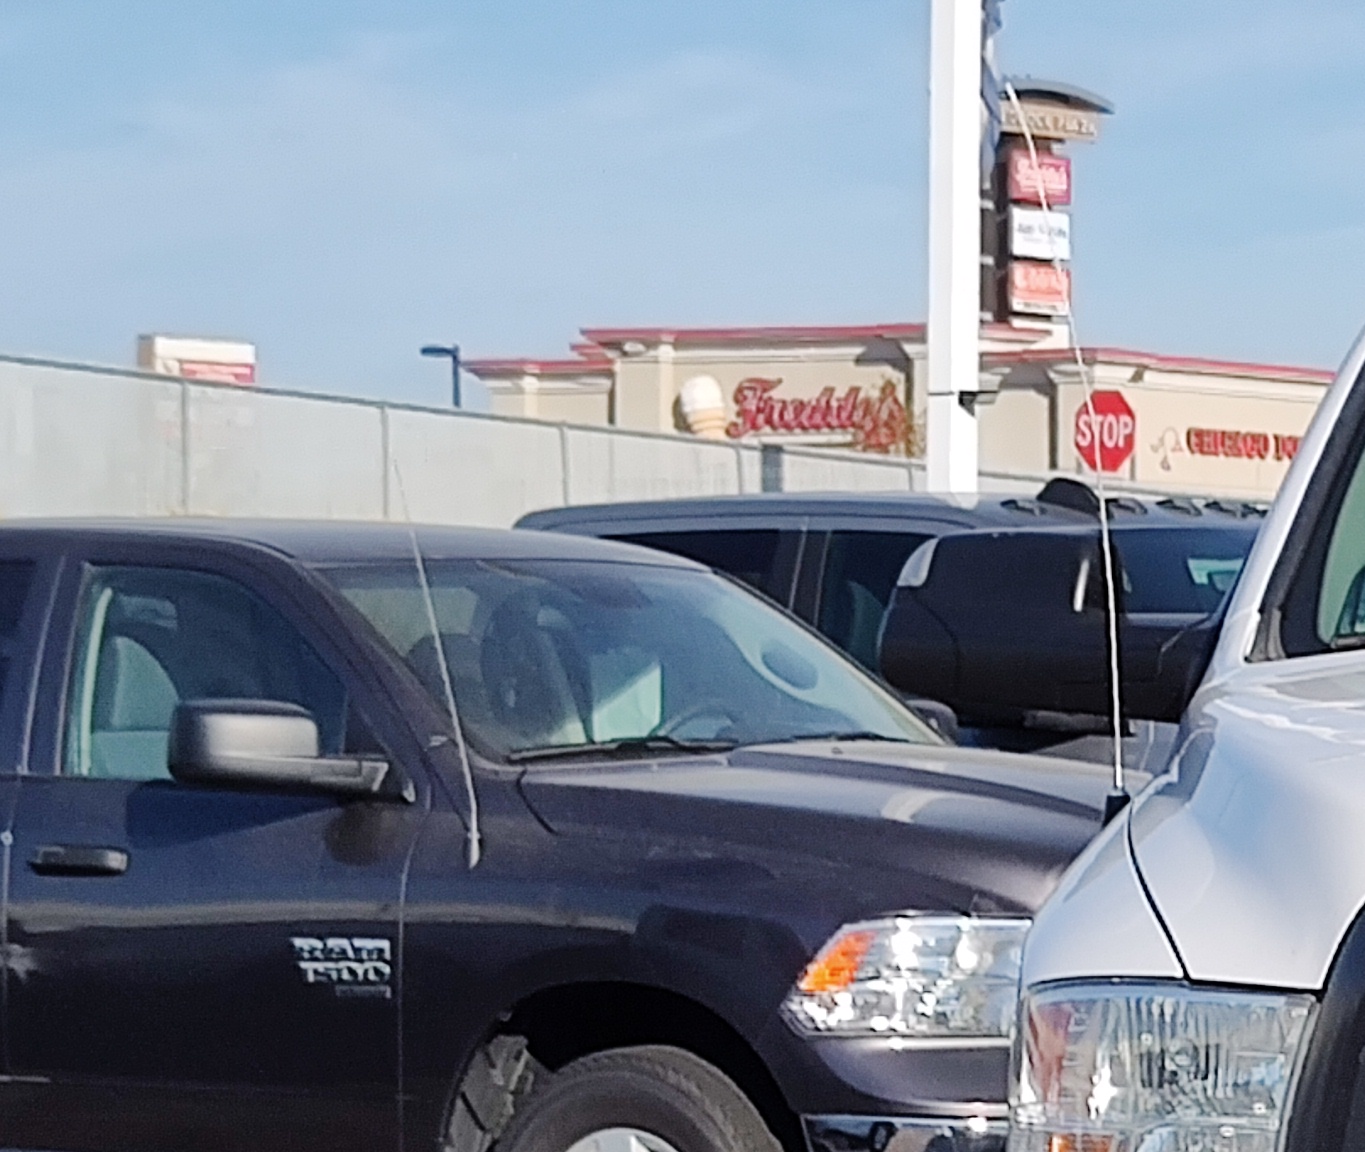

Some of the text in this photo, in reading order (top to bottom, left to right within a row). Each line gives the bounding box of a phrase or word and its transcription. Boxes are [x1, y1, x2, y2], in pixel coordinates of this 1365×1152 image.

[1075, 413, 1133, 449] STOP
[291, 937, 391, 960] RAM
[299, 960, 391, 983] 1500
